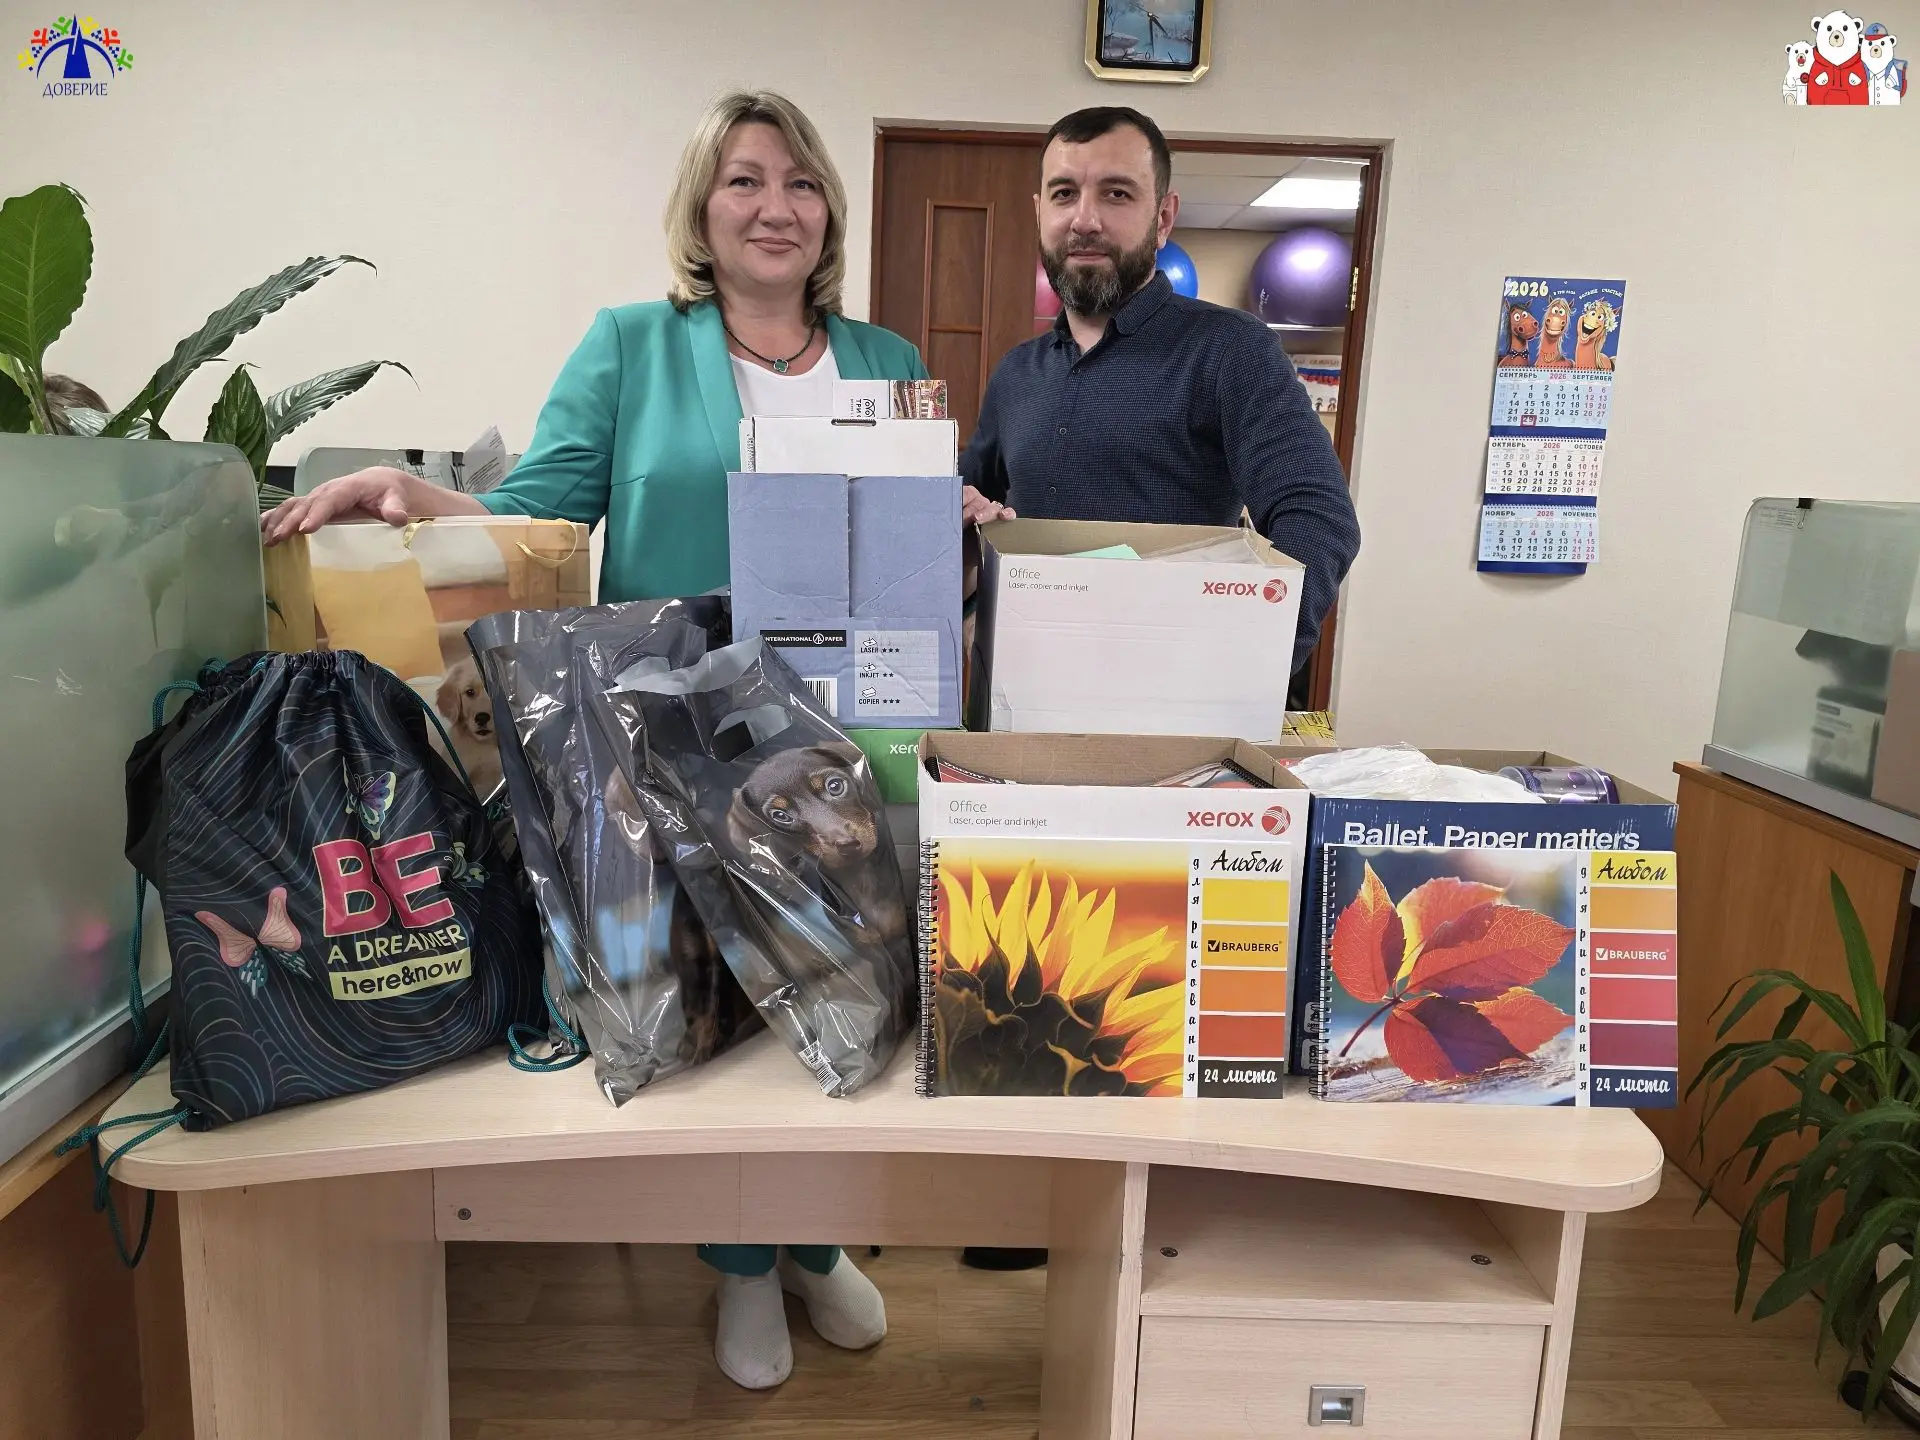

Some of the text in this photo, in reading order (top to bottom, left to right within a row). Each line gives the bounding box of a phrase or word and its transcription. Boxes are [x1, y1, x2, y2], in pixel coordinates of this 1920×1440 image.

[1509, 281, 1549, 297] 2026
[1009, 568, 1040, 579] Office
[1008, 581, 1028, 589] Laser,
[1069, 584, 1088, 592] inkjet
[1202, 580, 1258, 596] xerox
[949, 800, 987, 813] Office
[948, 816, 1048, 828] Laser, copier and inkjet
[1186, 811, 1254, 828] xerox
[1444, 825, 1528, 848] Paper
[1535, 828, 1640, 850] matters
[1210, 849, 1284, 873] Альбом
[1597, 858, 1668, 881] Альбом
[312, 831, 455, 937] BE
[328, 924, 466, 964] A DREAMER
[1222, 941, 1279, 952] BRAUBERG
[1610, 950, 1667, 961] BRAUBERG
[342, 959, 463, 994] here&now
[1204, 1068, 1277, 1085] 24 листа
[1596, 1077, 1670, 1094] 24 листа
